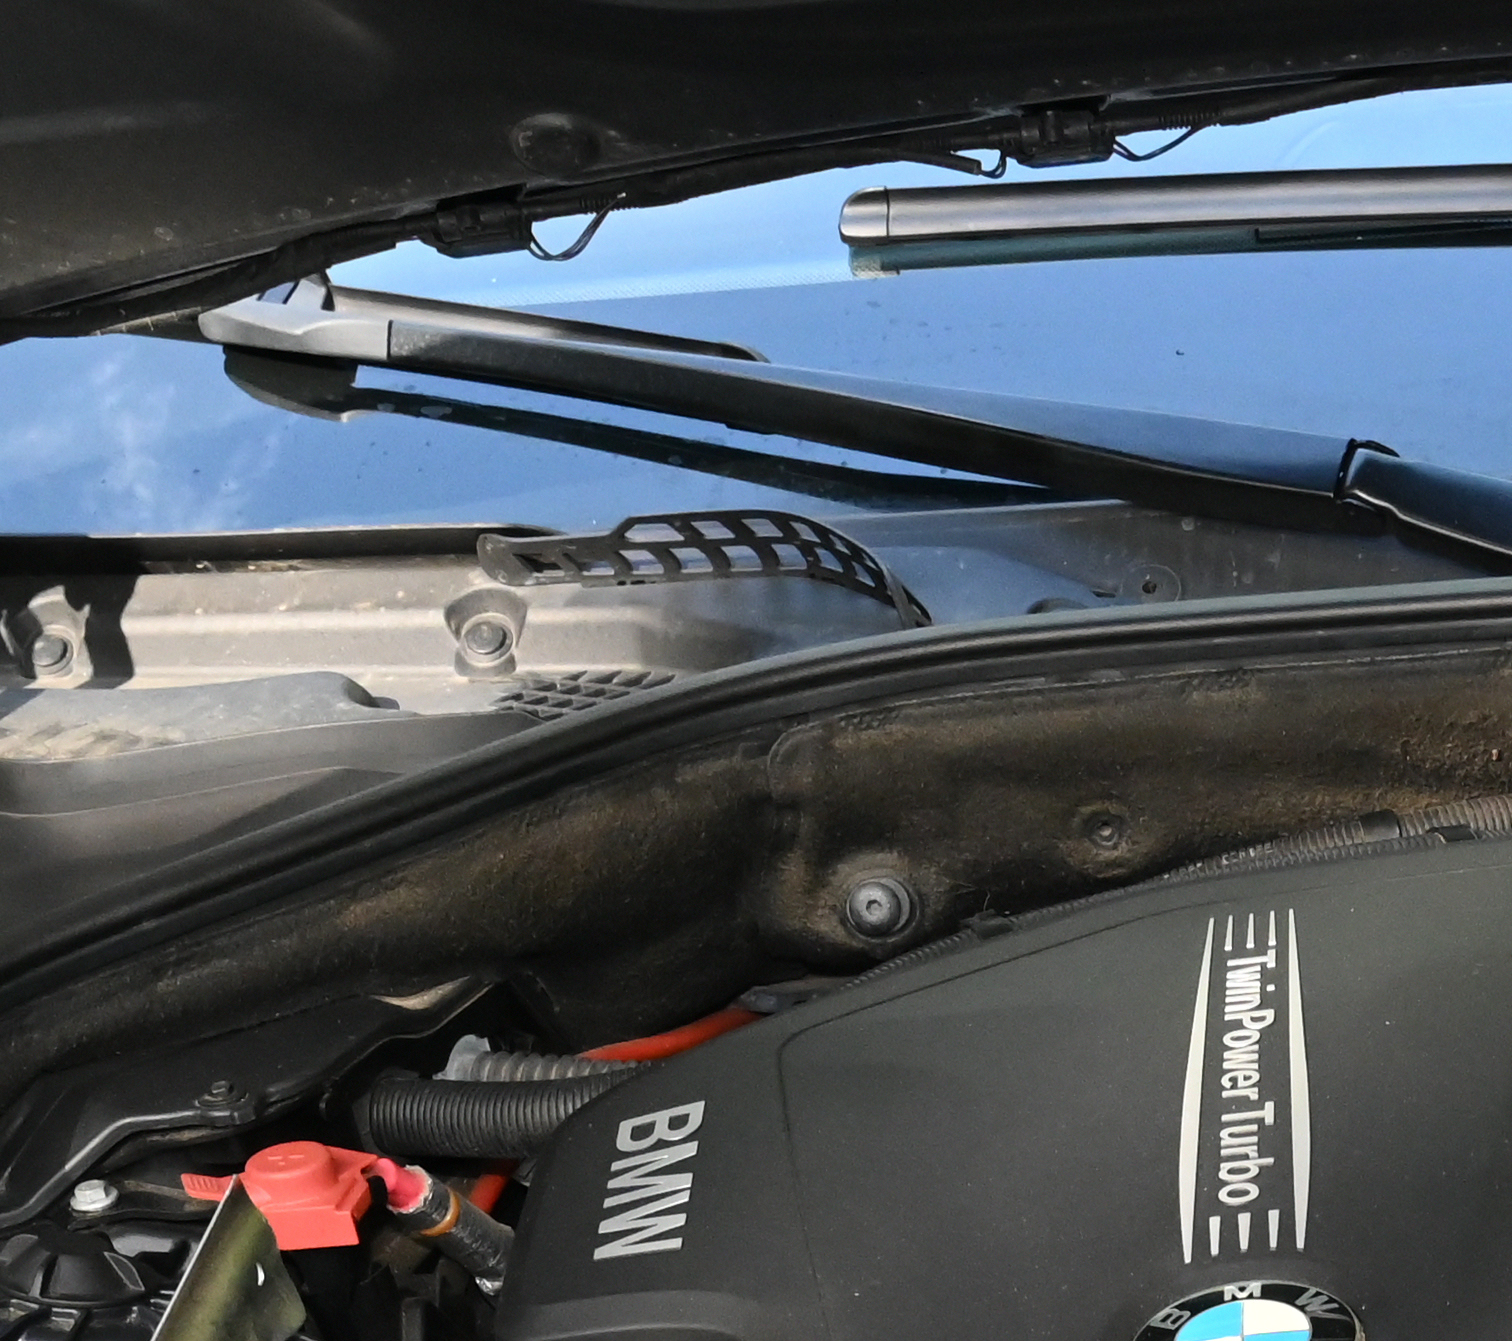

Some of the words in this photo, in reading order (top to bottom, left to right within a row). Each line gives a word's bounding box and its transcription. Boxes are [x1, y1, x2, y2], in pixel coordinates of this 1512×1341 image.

[1226, 954, 1278, 1100] TwinPower
[593, 1100, 706, 1261] BMW
[1217, 1100, 1275, 1206] Turbo
[1149, 1281, 1341, 1332] BMW
